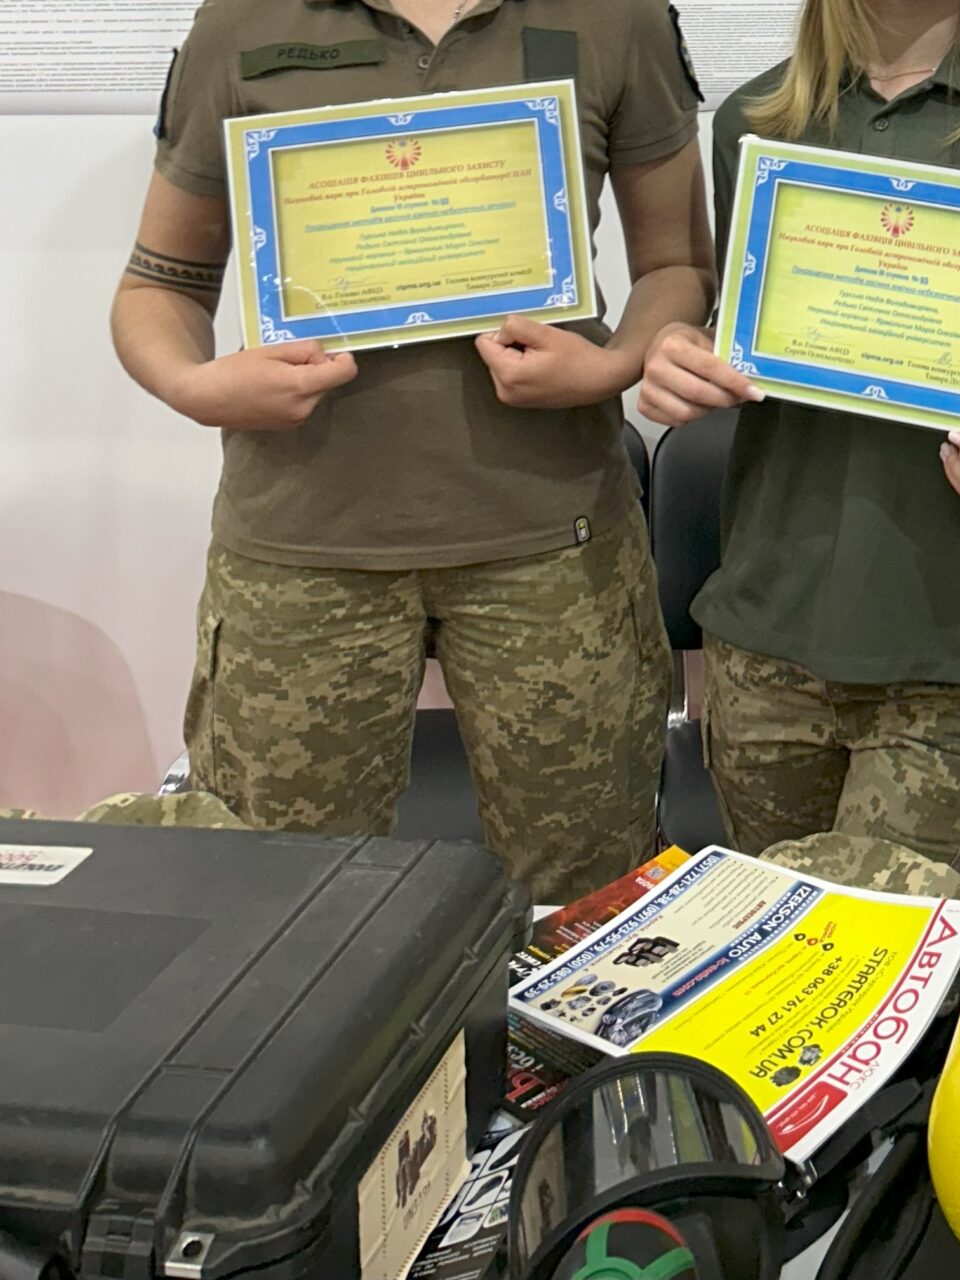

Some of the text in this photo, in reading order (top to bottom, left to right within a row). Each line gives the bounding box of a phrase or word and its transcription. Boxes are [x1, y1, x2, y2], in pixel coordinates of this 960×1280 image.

[276, 46, 341, 62] РЕДЬКО
[698, 855, 720, 873] (057)
[655, 866, 700, 906] 721-28-38,
[637, 899, 659, 923] (097)
[762, 885, 812, 931] IZEKSON
[593, 919, 640, 953] 923-95-79,
[728, 932, 762, 957] AUTO
[568, 948, 595, 969] (050)
[524, 964, 571, 999] 085-29-39
[750, 955, 843, 1038] +38 063 761 27 44
[749, 946, 889, 1079] STARTEROK.COM.UA
